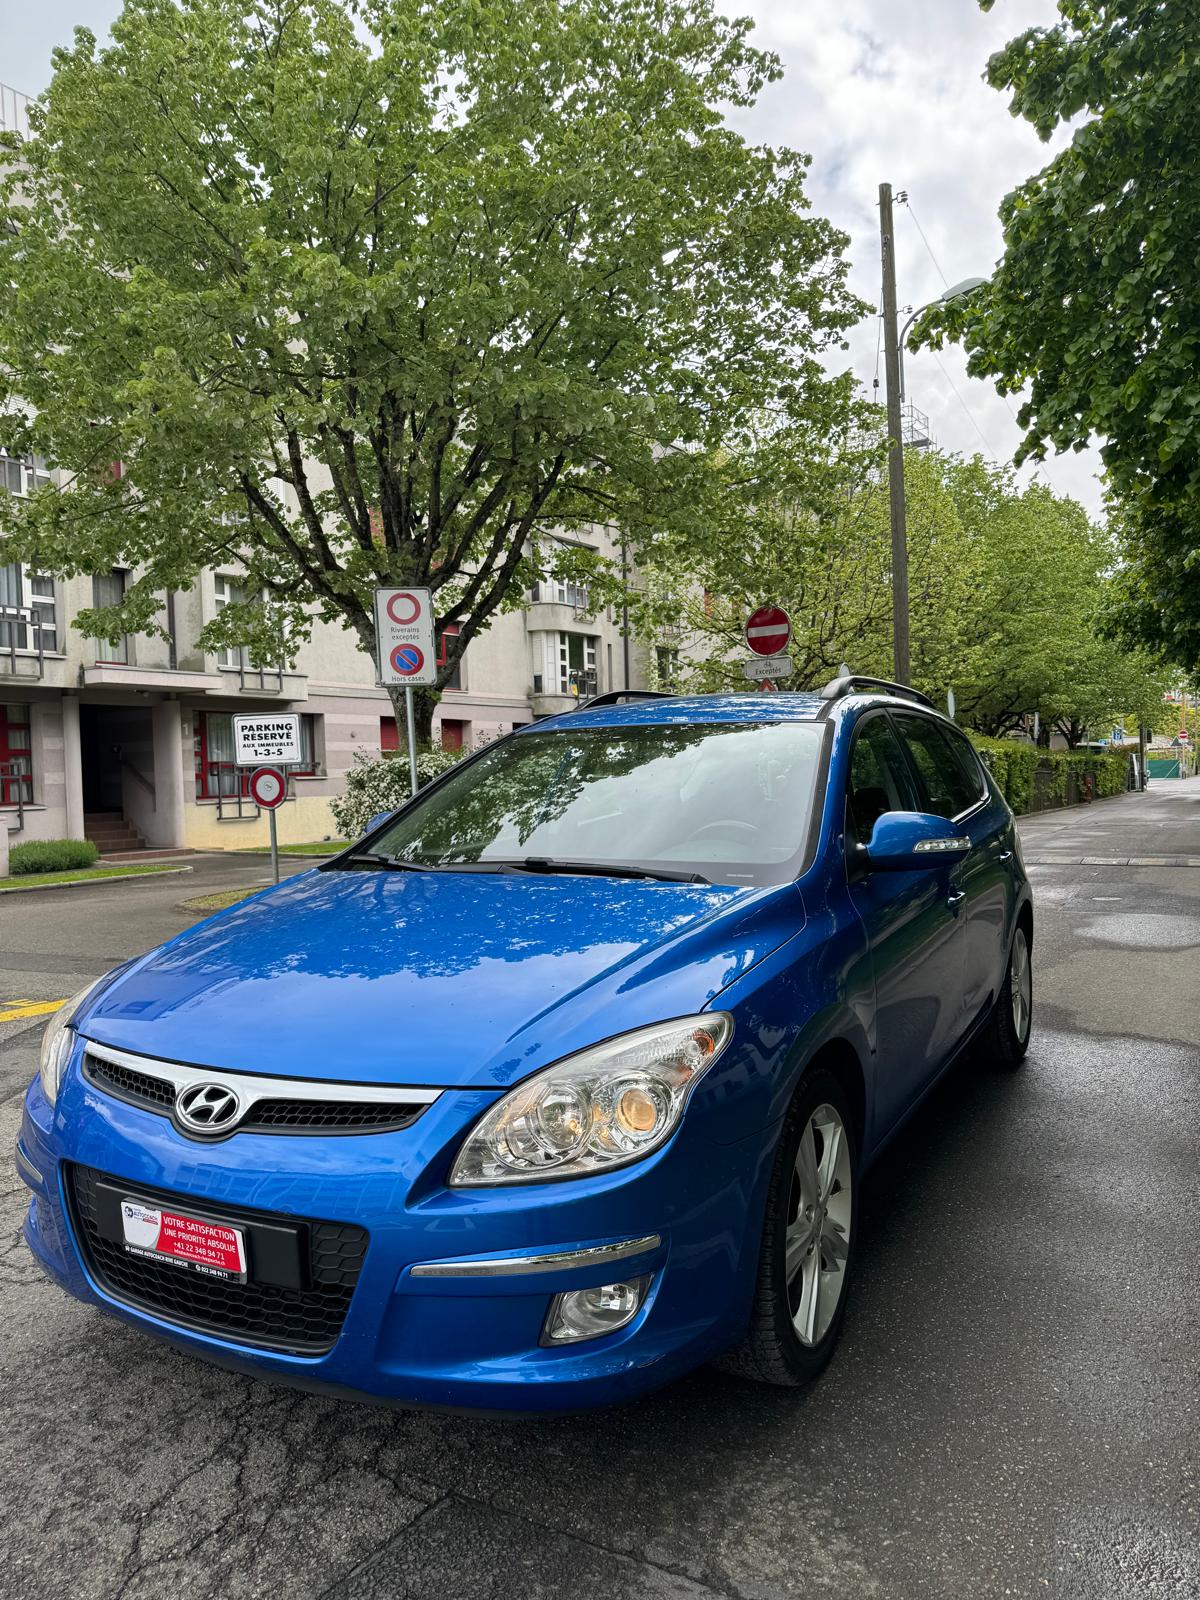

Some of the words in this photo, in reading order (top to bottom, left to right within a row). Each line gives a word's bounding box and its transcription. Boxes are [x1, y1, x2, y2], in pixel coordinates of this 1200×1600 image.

[755, 667, 782, 675] Exceptés
[241, 723, 293, 732] PARKING
[243, 731, 292, 741] RÉSERVÉ
[253, 748, 283, 757] 1-3-5
[163, 1216, 185, 1229] VOTRE
[186, 1222, 235, 1241] SATISFACTION
[164, 1227, 177, 1238] UNE
[178, 1231, 206, 1245] PRIORITE
[207, 1239, 236, 1253] ABSOLUE
[173, 1241, 184, 1250] +41
[185, 1243, 194, 1252] 22
[195, 1246, 207, 1255] 348
[207, 1250, 216, 1258] 94
[216, 1251, 225, 1260] 71
